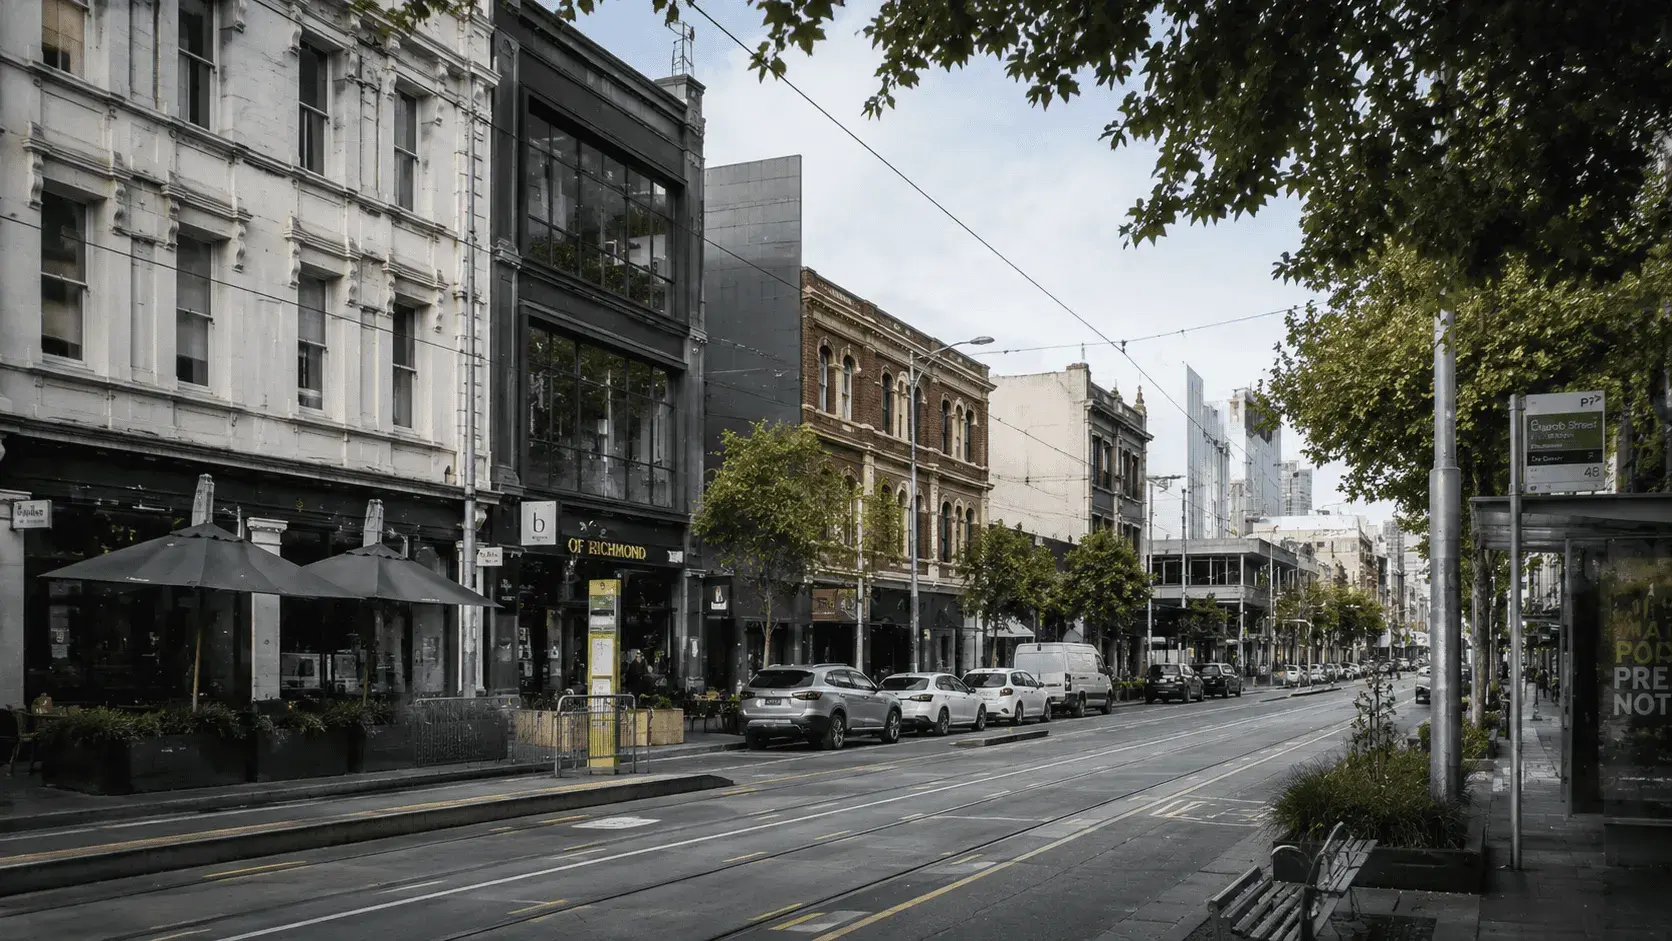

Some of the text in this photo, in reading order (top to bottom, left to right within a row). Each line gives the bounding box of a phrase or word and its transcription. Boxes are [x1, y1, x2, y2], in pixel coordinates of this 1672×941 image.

[1584, 466, 1600, 478] 48
[533, 512, 545, 533] b
[567, 537, 647, 560] OF RICHMOND
[1613, 666, 1669, 691] PRE
[1613, 692, 1672, 716] NOT
